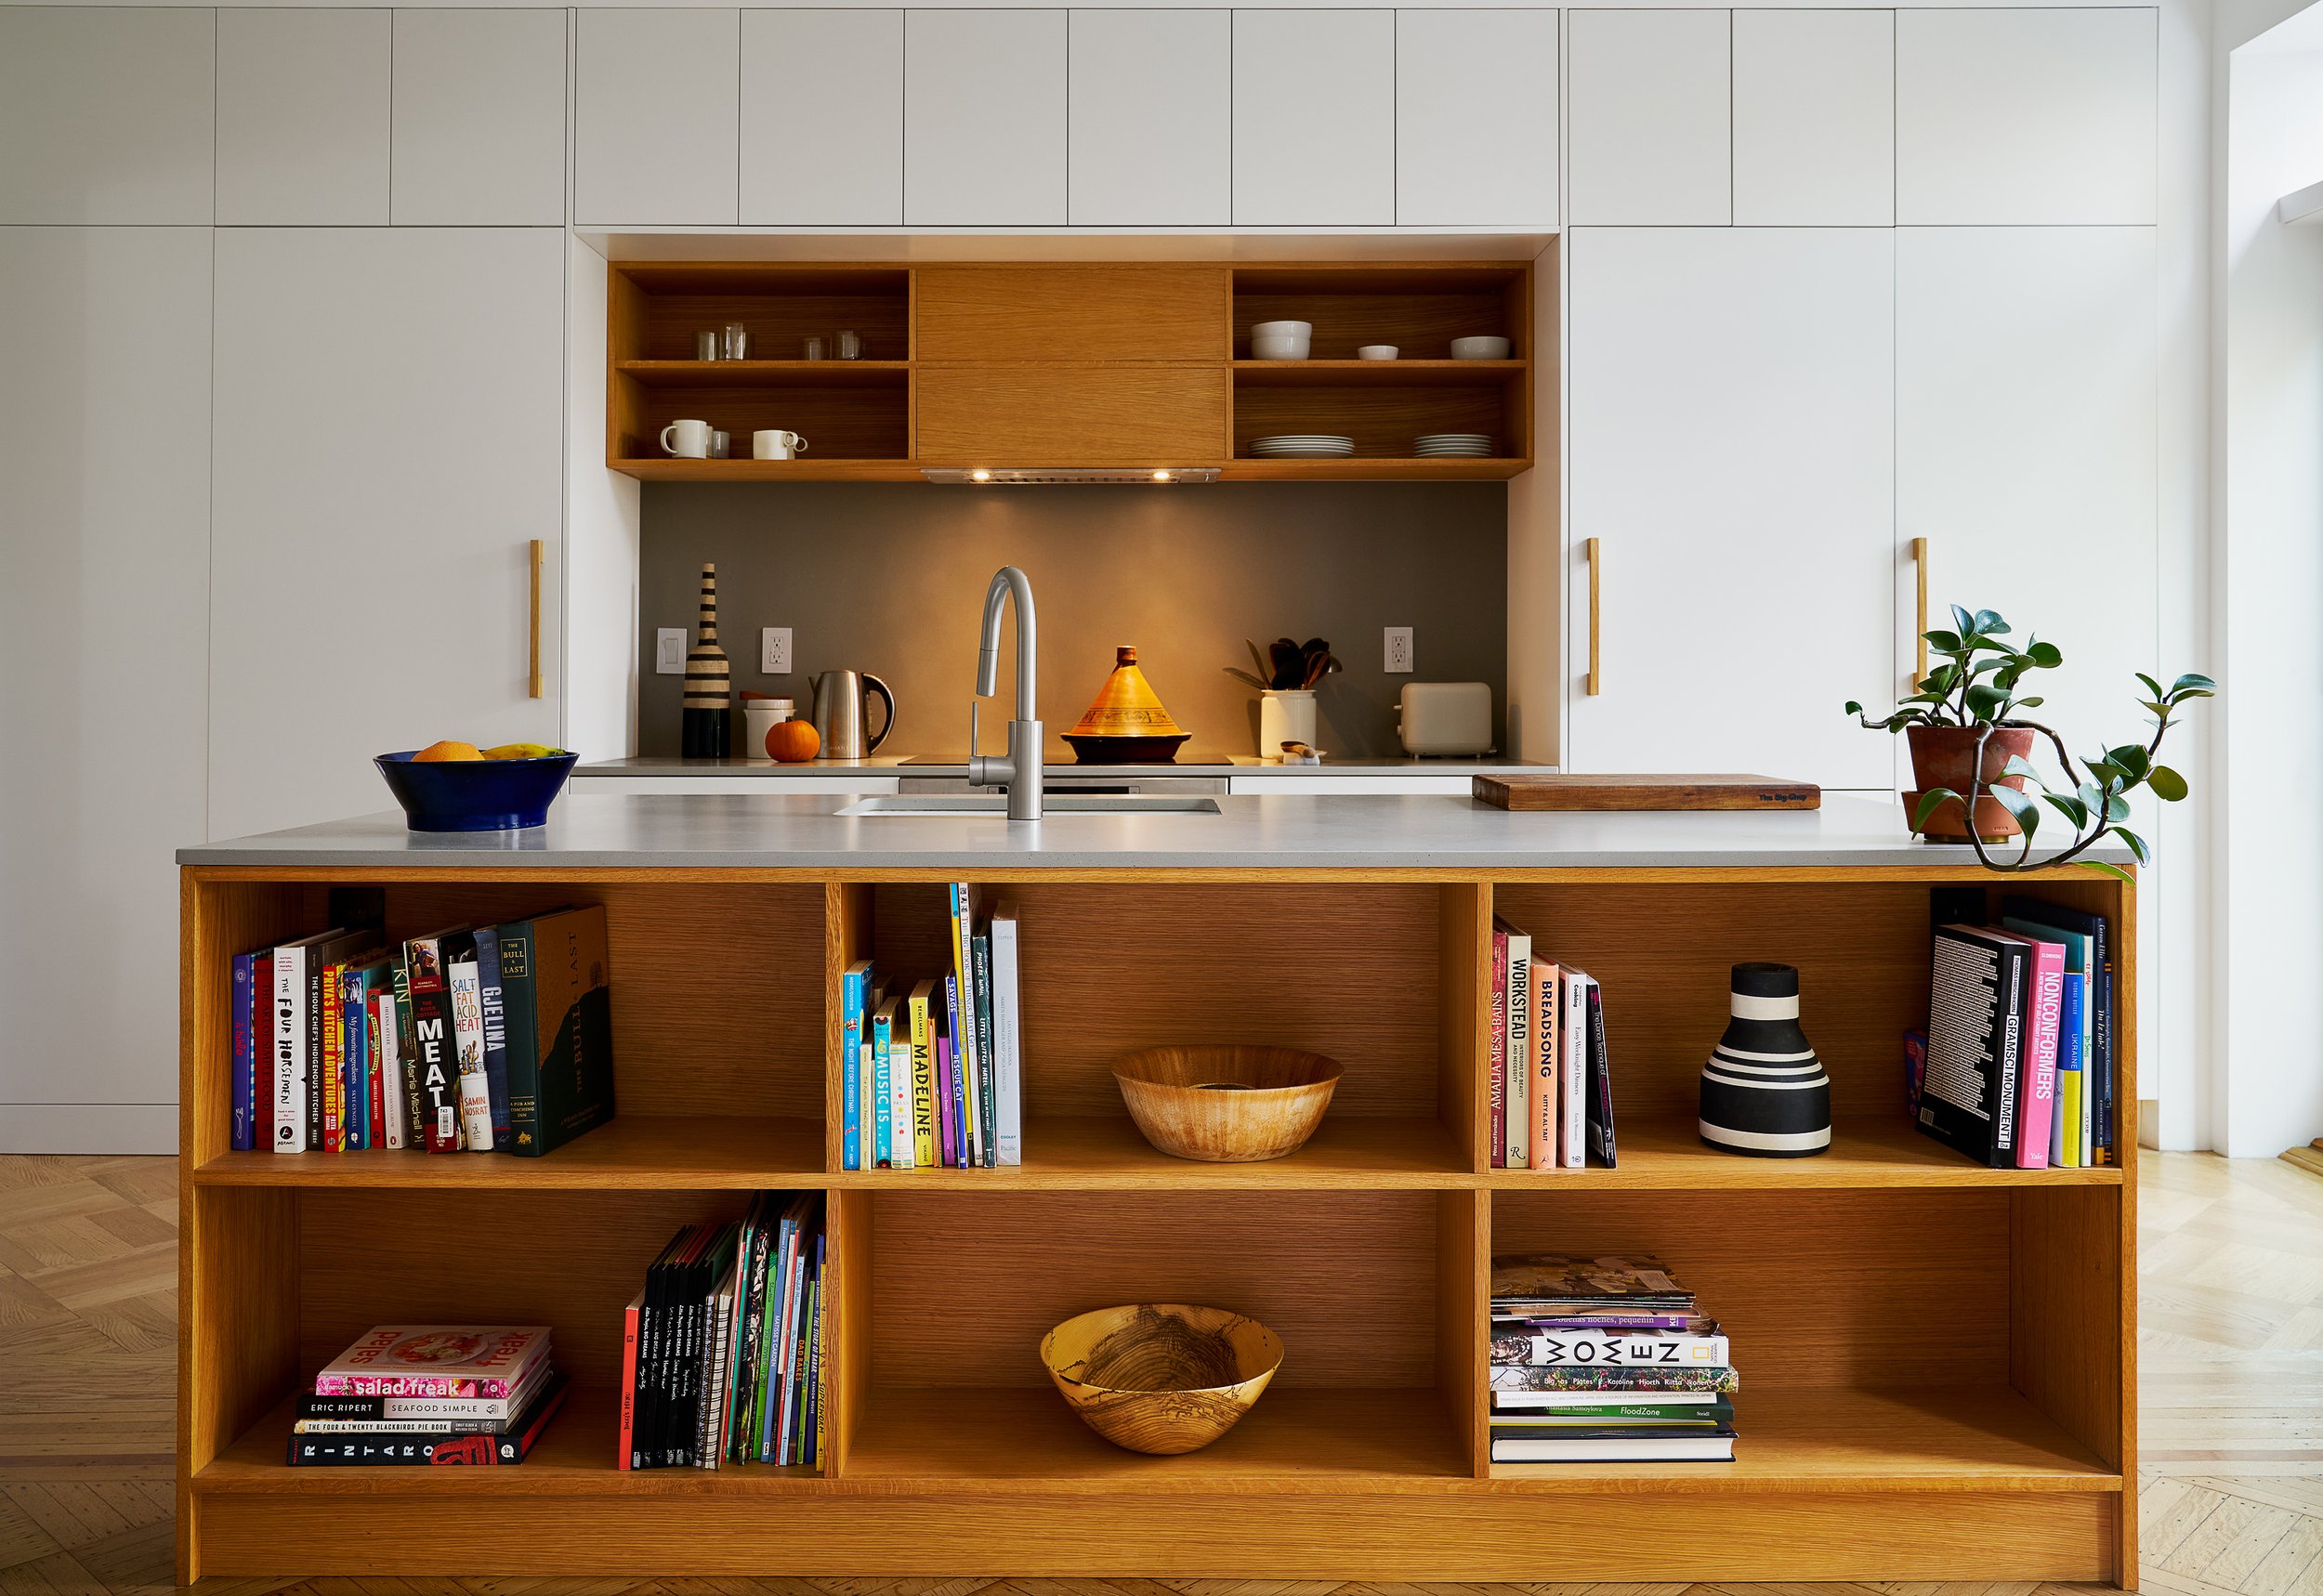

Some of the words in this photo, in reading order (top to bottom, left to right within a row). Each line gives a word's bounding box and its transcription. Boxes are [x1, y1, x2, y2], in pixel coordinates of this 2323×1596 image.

[503, 950, 525, 959] BULL
[504, 965, 525, 974] LAST
[281, 977, 290, 993] THE
[322, 971, 335, 1007] PRIYA'S
[393, 967, 410, 1003] KIN
[452, 978, 476, 993] SALT
[456, 991, 474, 1006] FAT
[948, 983, 956, 1014] SAVAGE
[1511, 958, 1527, 1040] WORKSTEAD
[1572, 984, 1581, 1008] Cooking
[2010, 979, 2019, 1014] HIRSCHHORN
[277, 998, 294, 1034] FOUR
[348, 1015, 358, 1027] My
[455, 1017, 480, 1032] HEAT
[456, 1004, 478, 1019] ACID
[481, 986, 505, 1053] GJELINA
[323, 1010, 335, 1052] KITCHEN
[1491, 991, 1503, 1063] MESA-BAINS
[1541, 980, 1553, 1079] BREADSONG
[1573, 1027, 1582, 1040] Easy
[1595, 1023, 1603, 1041] Dance
[2035, 971, 2061, 1100] NONCONFORMERS
[1573, 1040, 1581, 1072] Weeknight
[1596, 1041, 1607, 1068] Technique
[2004, 1017, 2017, 1070] GRAMSCI
[277, 1040, 293, 1105] HORSEMEN
[349, 1052, 359, 1085] ingredients
[406, 1059, 418, 1091] Marie
[417, 1018, 447, 1107] MEAT
[952, 1054, 962, 1085] RESCUE
[324, 1054, 336, 1115] ADVENTURES
[876, 1055, 889, 1105] MUSIC
[913, 1043, 931, 1136] MADELINE
[954, 1086, 963, 1102] CAT
[1491, 1066, 1502, 1110] AMALIA
[410, 1092, 423, 1131] Mitchell
[464, 1096, 486, 1106] SAMIN
[464, 1105, 488, 1117] NOSRAT
[1999, 1072, 2014, 1139] MONUMENT
[877, 1109, 889, 1123] IS
[1542, 1119, 1549, 1127] AL
[2030, 1152, 2043, 1160] Yale
[772, 1315, 781, 1343] MATISSE'S
[348, 1331, 403, 1365] salad
[476, 1331, 534, 1367] freak
[797, 1339, 806, 1356] DAD
[811, 1345, 819, 1354] OF
[1545, 1338, 1681, 1366] WOMEN
[794, 1357, 804, 1382] BAKES
[810, 1354, 819, 1373] BABAR
[355, 1379, 406, 1395] salad
[409, 1380, 460, 1396] freak
[1543, 1377, 1555, 1386] Big
[310, 1404, 335, 1412] ERIC
[337, 1404, 373, 1412] RIPERT
[442, 1405, 479, 1413] SIMPLE
[818, 1381, 826, 1434] SUPERWORM
[1620, 1406, 1660, 1416] FloodZone
[304, 1446, 434, 1458] RINTARO
